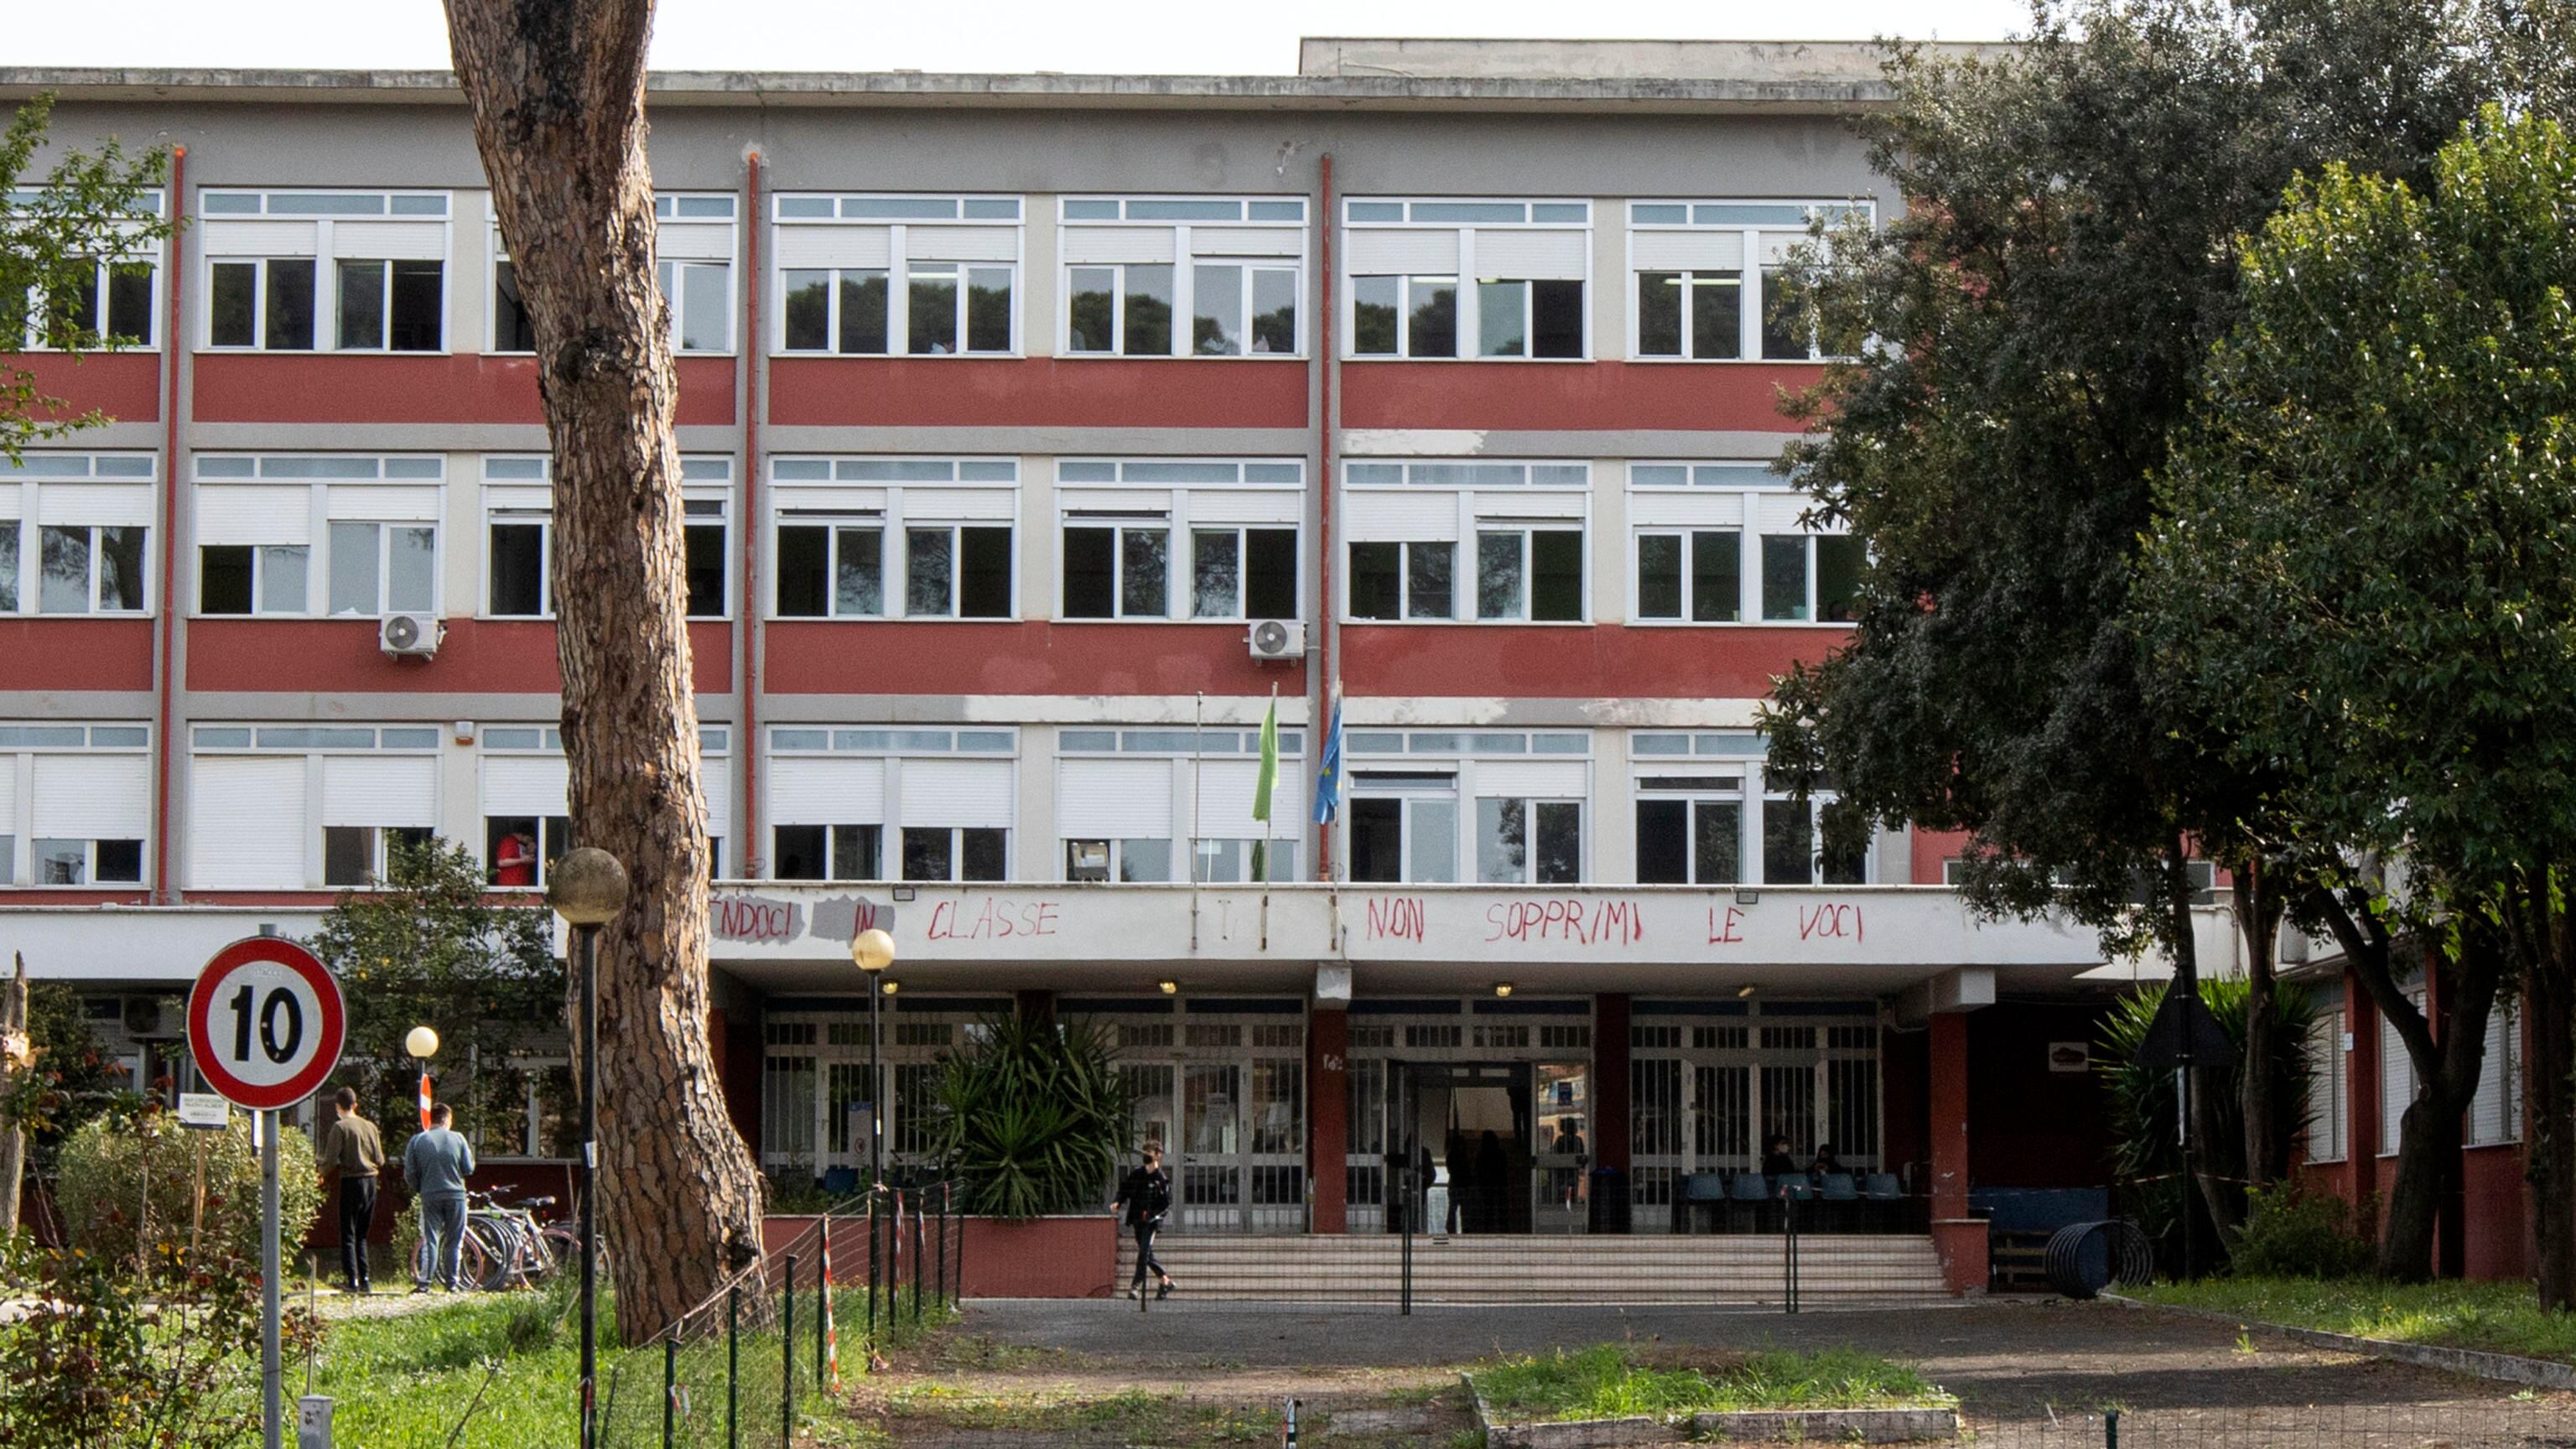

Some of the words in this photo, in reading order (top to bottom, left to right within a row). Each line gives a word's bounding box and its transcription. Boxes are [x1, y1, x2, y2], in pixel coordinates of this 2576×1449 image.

[853, 904, 875, 939] IN
[927, 897, 1060, 939] CLASSE
[1367, 897, 1424, 943] NON
[1485, 899, 1643, 946] SOPPRIMI
[1708, 906, 1744, 944] LE
[1800, 903, 1863, 945] VOCI
[230, 984, 303, 1064] 10
